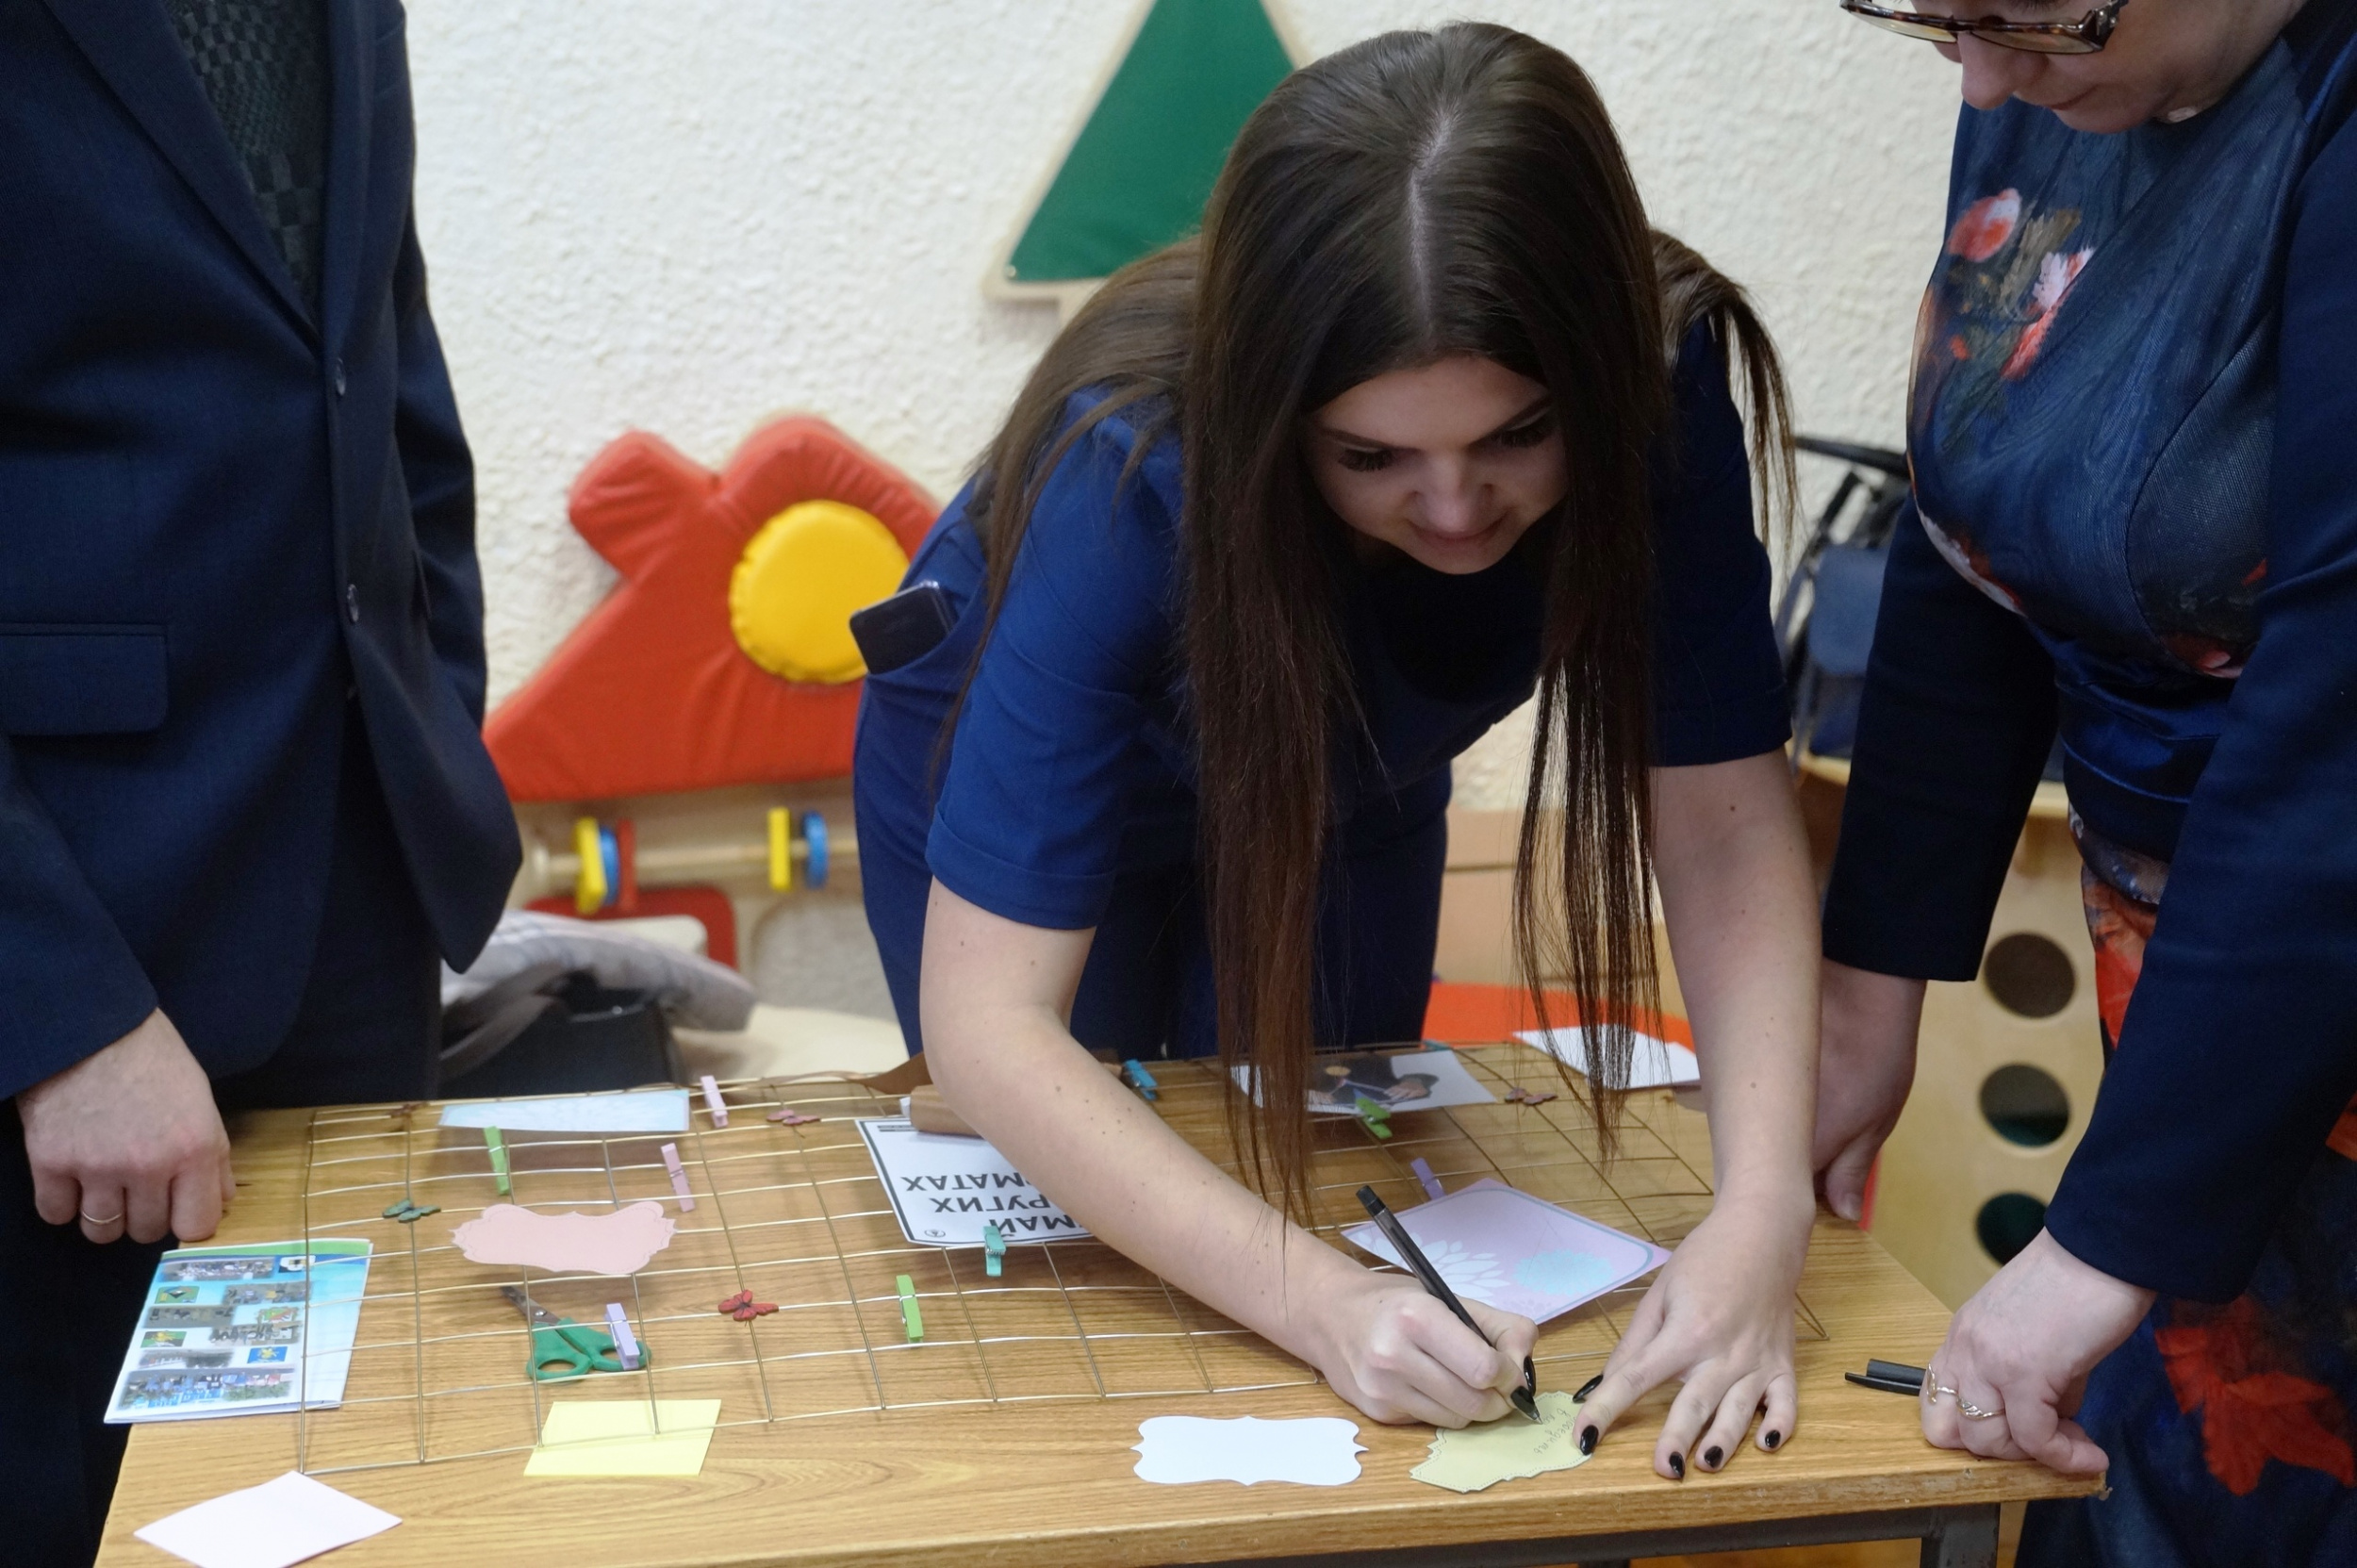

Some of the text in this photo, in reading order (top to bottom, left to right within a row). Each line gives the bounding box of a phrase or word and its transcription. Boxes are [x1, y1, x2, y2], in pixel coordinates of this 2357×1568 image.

[900, 1172, 1031, 1192] МАТАХ
[929, 1194, 1051, 1213] РУГИХ
[989, 1213, 1080, 1238] МАЙ
